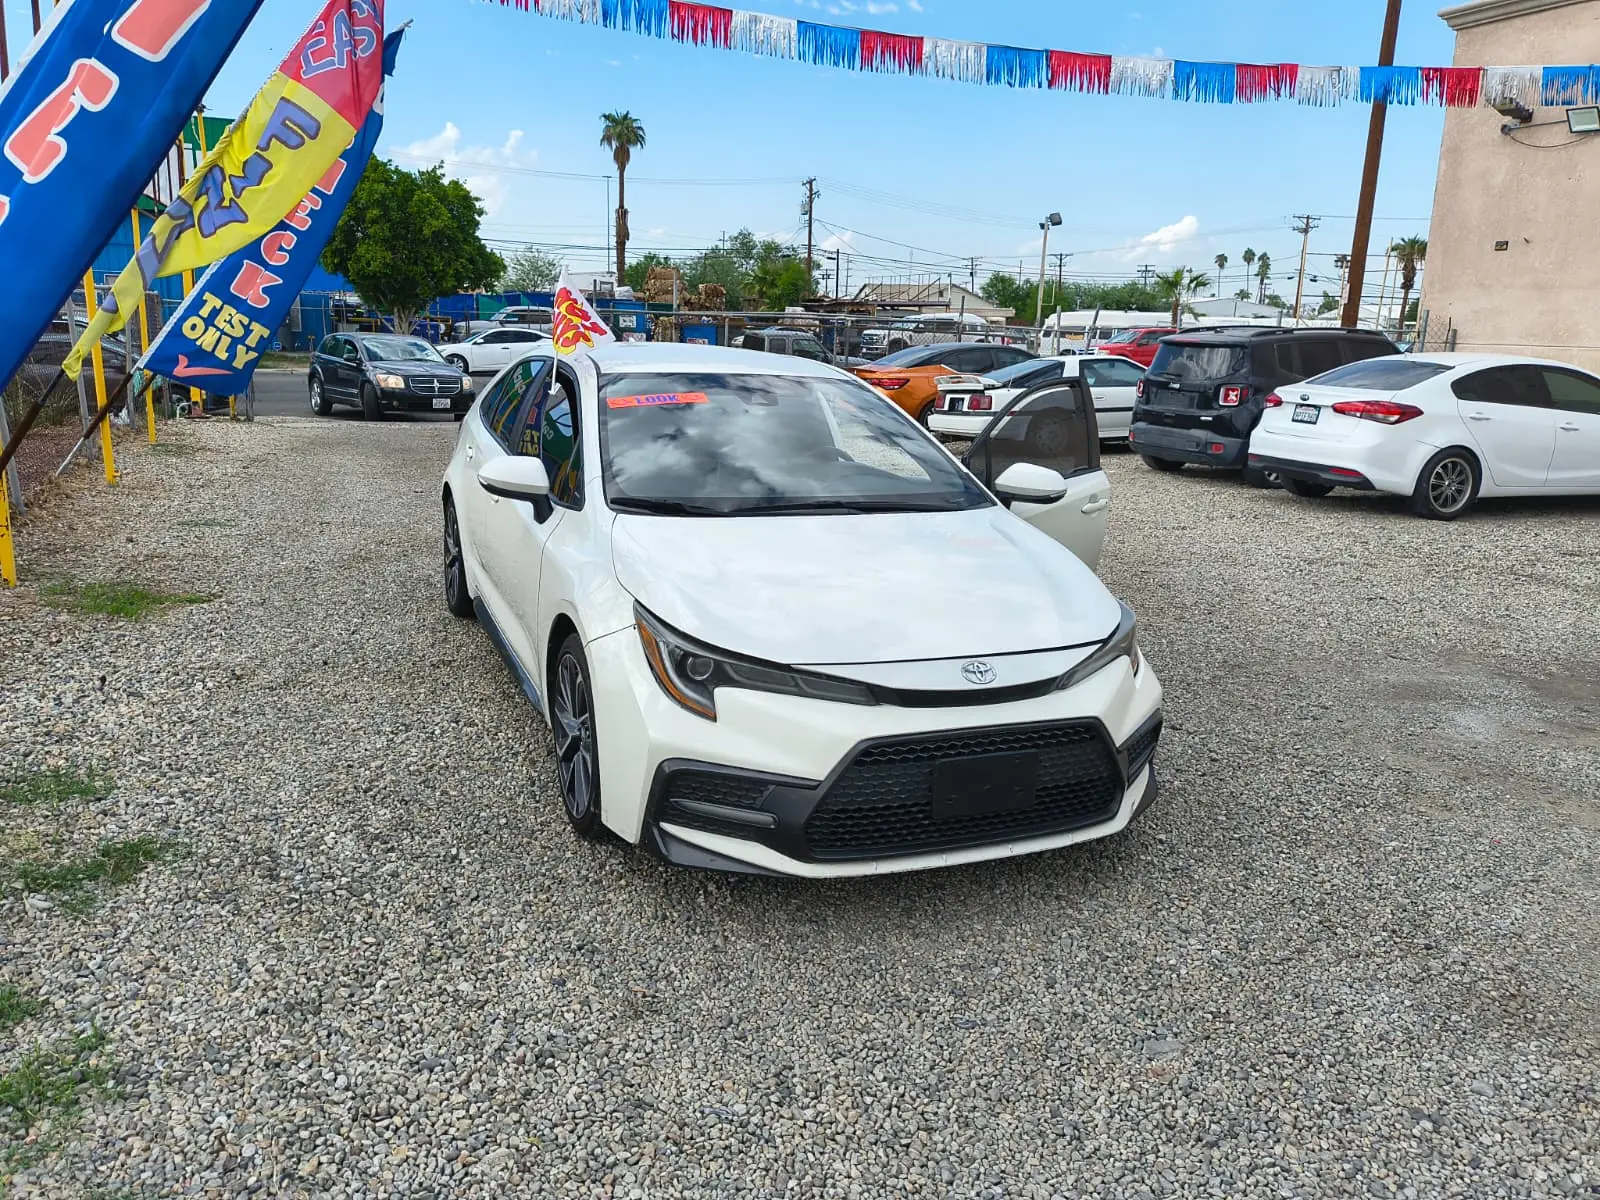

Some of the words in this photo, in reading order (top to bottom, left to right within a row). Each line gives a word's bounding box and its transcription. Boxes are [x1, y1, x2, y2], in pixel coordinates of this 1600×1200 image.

[181, 315, 258, 370] ONLY
[198, 292, 270, 348] TEST
[634, 393, 679, 405] LOOK
